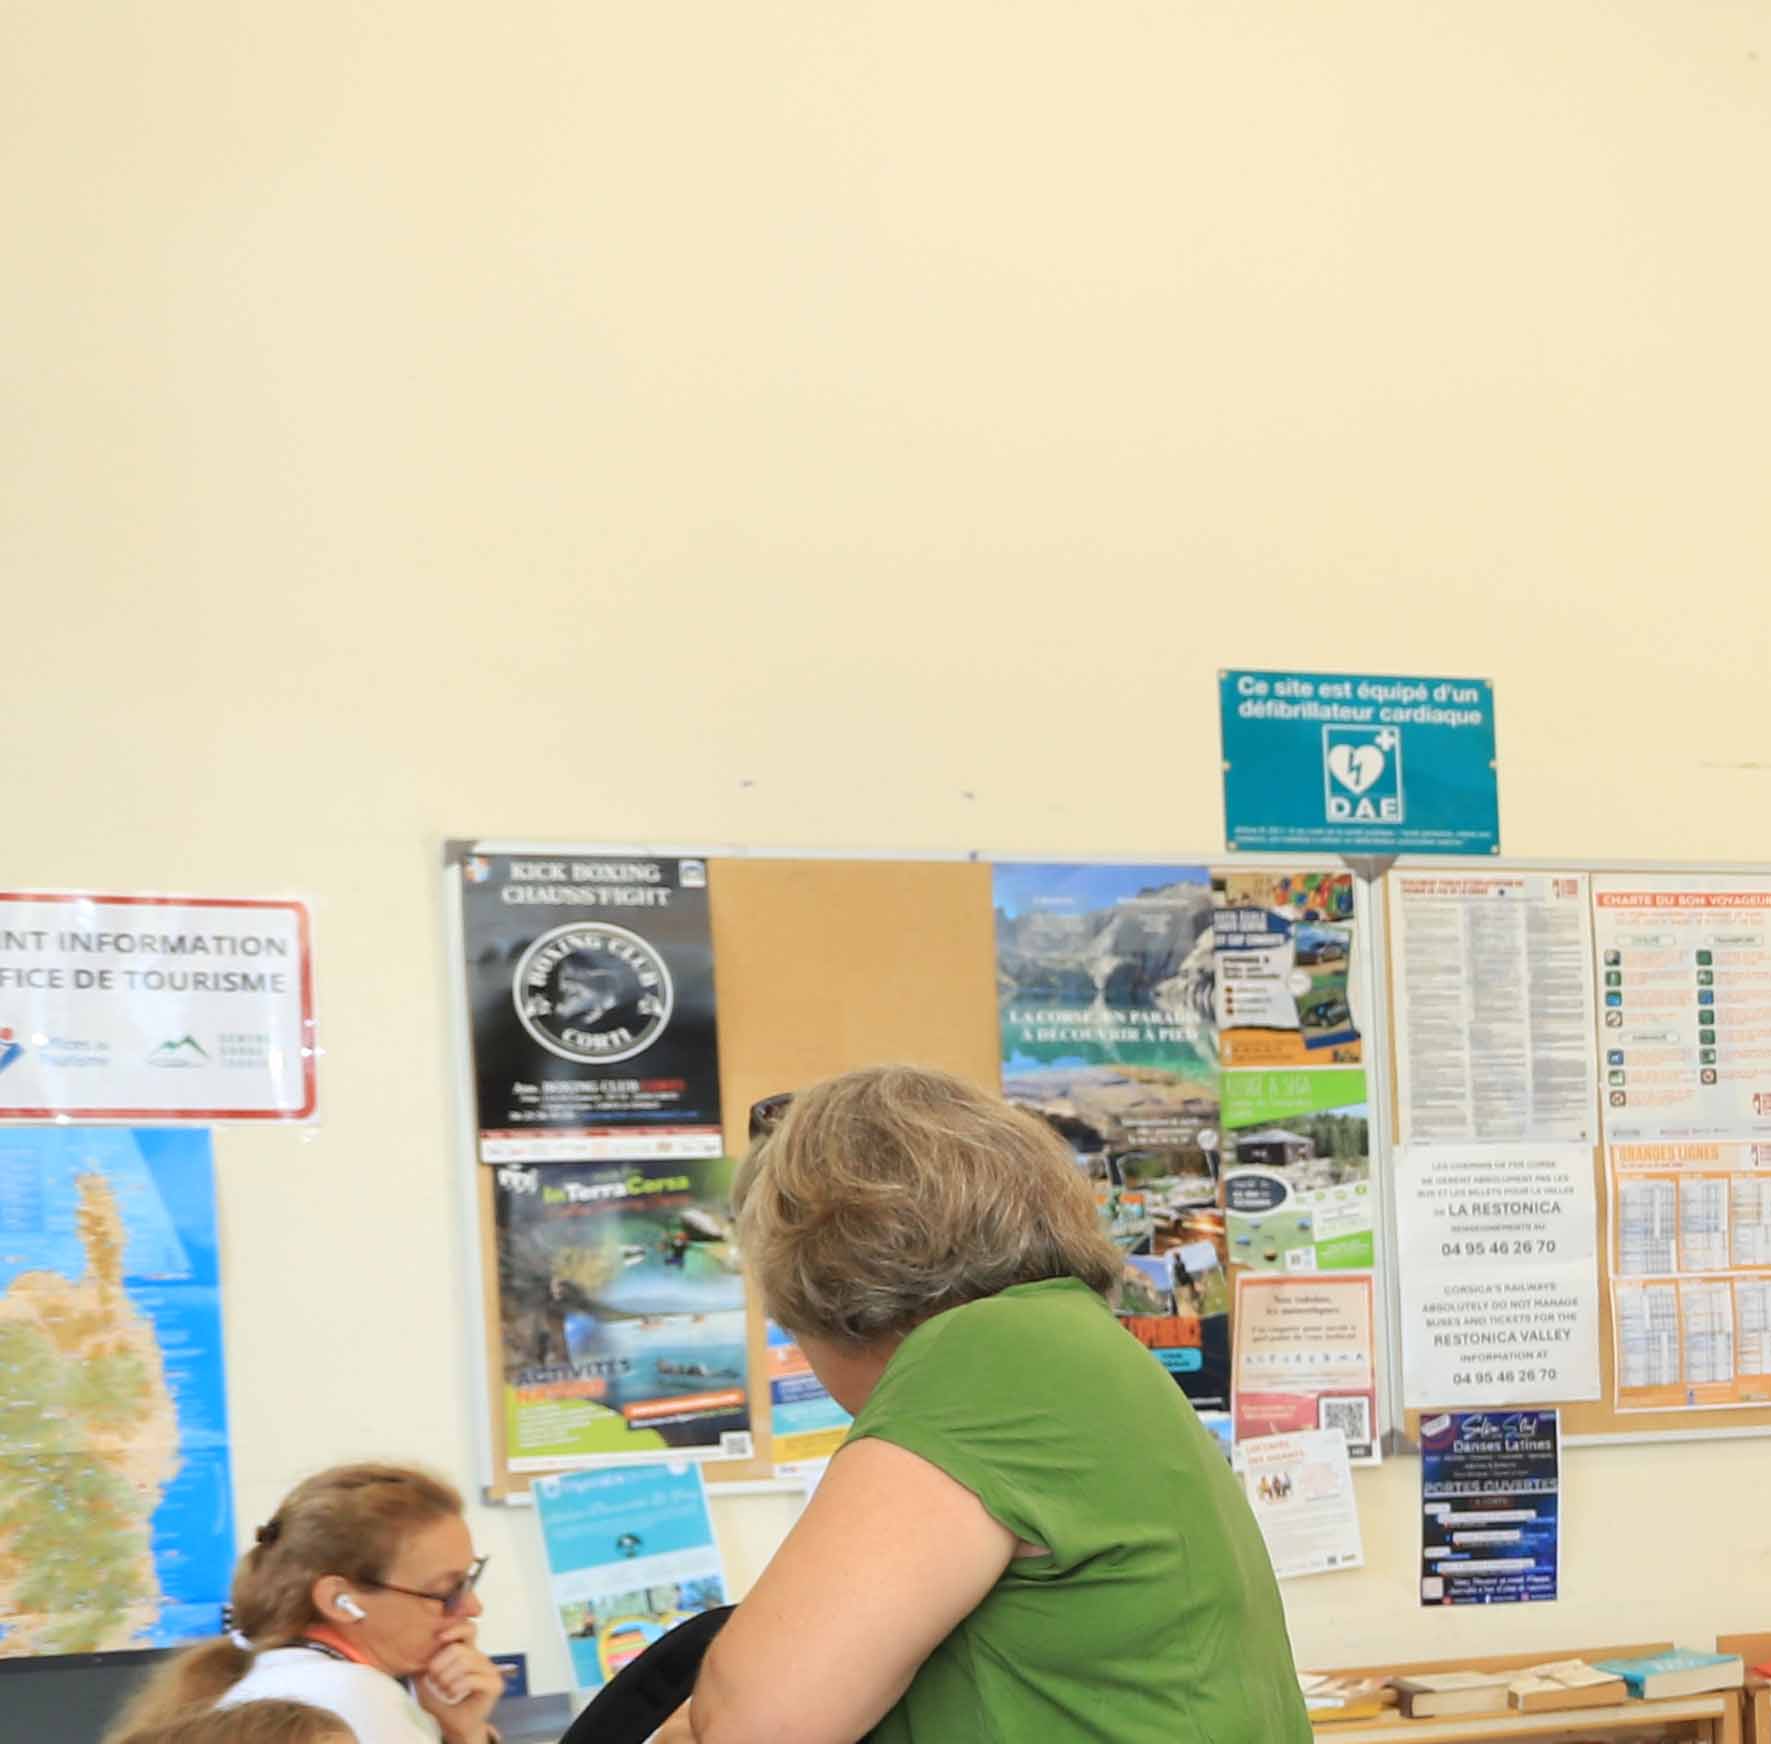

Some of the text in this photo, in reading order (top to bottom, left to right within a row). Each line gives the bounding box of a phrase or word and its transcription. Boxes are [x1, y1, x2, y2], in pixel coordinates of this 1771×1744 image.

[1237, 676, 1479, 705] Ce site est équipé d'un
[1237, 698, 1483, 728] défibrillateur cardiaque
[1329, 797, 1399, 819] DAE
[510, 861, 661, 884] KICK BOXING
[1602, 895, 1652, 905] CHARTE
[1655, 895, 1675, 904] DU
[1678, 895, 1707, 905] BON
[58, 932, 287, 957] INFORMATION
[74, 969, 114, 990] DE
[122, 970, 287, 994] TOURISME
[1448, 1200, 1562, 1217] LA RESTONICA
[1440, 1239, 1557, 1257] 04 95 46 26 70
[1422, 1301, 1490, 1313] ABSOLUTELY
[1510, 1299, 1532, 1310] NOT
[1489, 1314, 1532, 1326] TICKETS
[1557, 1311, 1578, 1322] THE
[1433, 1328, 1573, 1348] RESTONICA VALLEY
[1453, 1368, 1558, 1387] 04 95 46 26 70
[1452, 1438, 1552, 1454] Danses Latines
